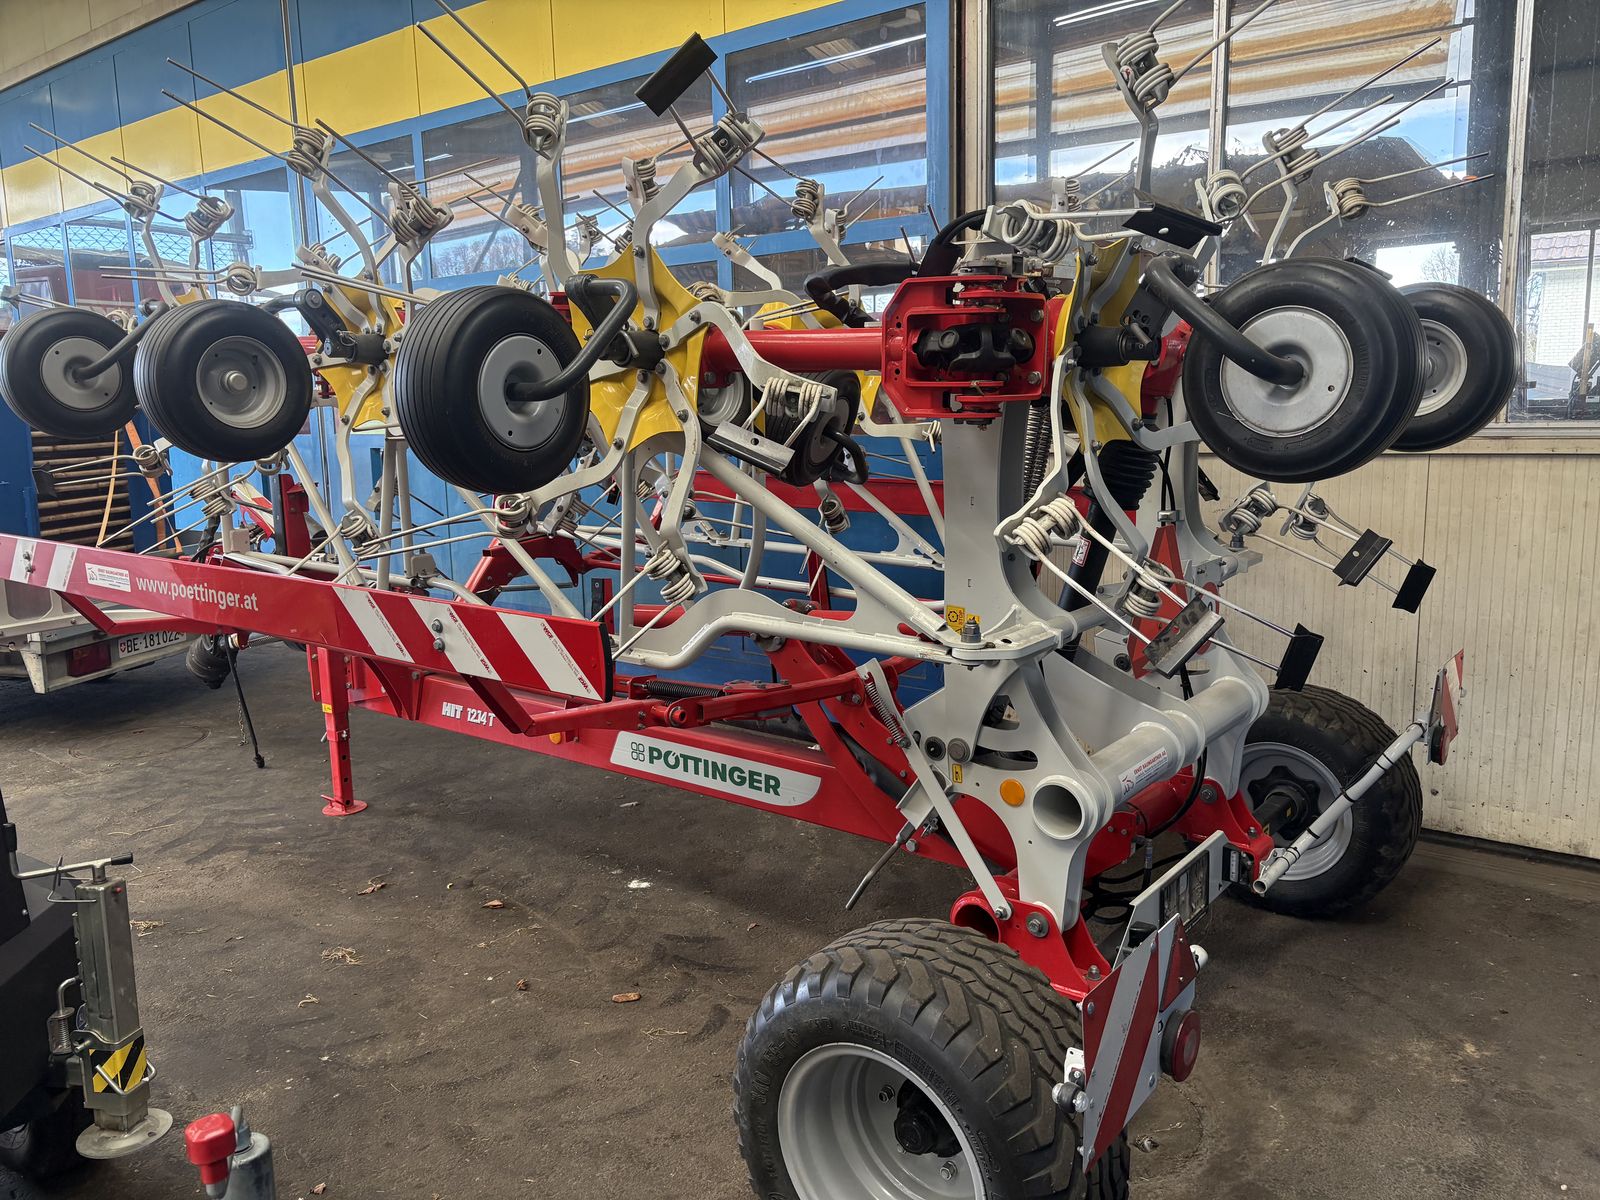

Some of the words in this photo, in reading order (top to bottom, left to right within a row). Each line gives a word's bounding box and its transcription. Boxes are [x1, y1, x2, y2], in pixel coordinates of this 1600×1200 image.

[136, 577, 259, 611] www.poettinger.at
[442, 701, 463, 719] HIT
[648, 745, 781, 797] PÖTTINGER
